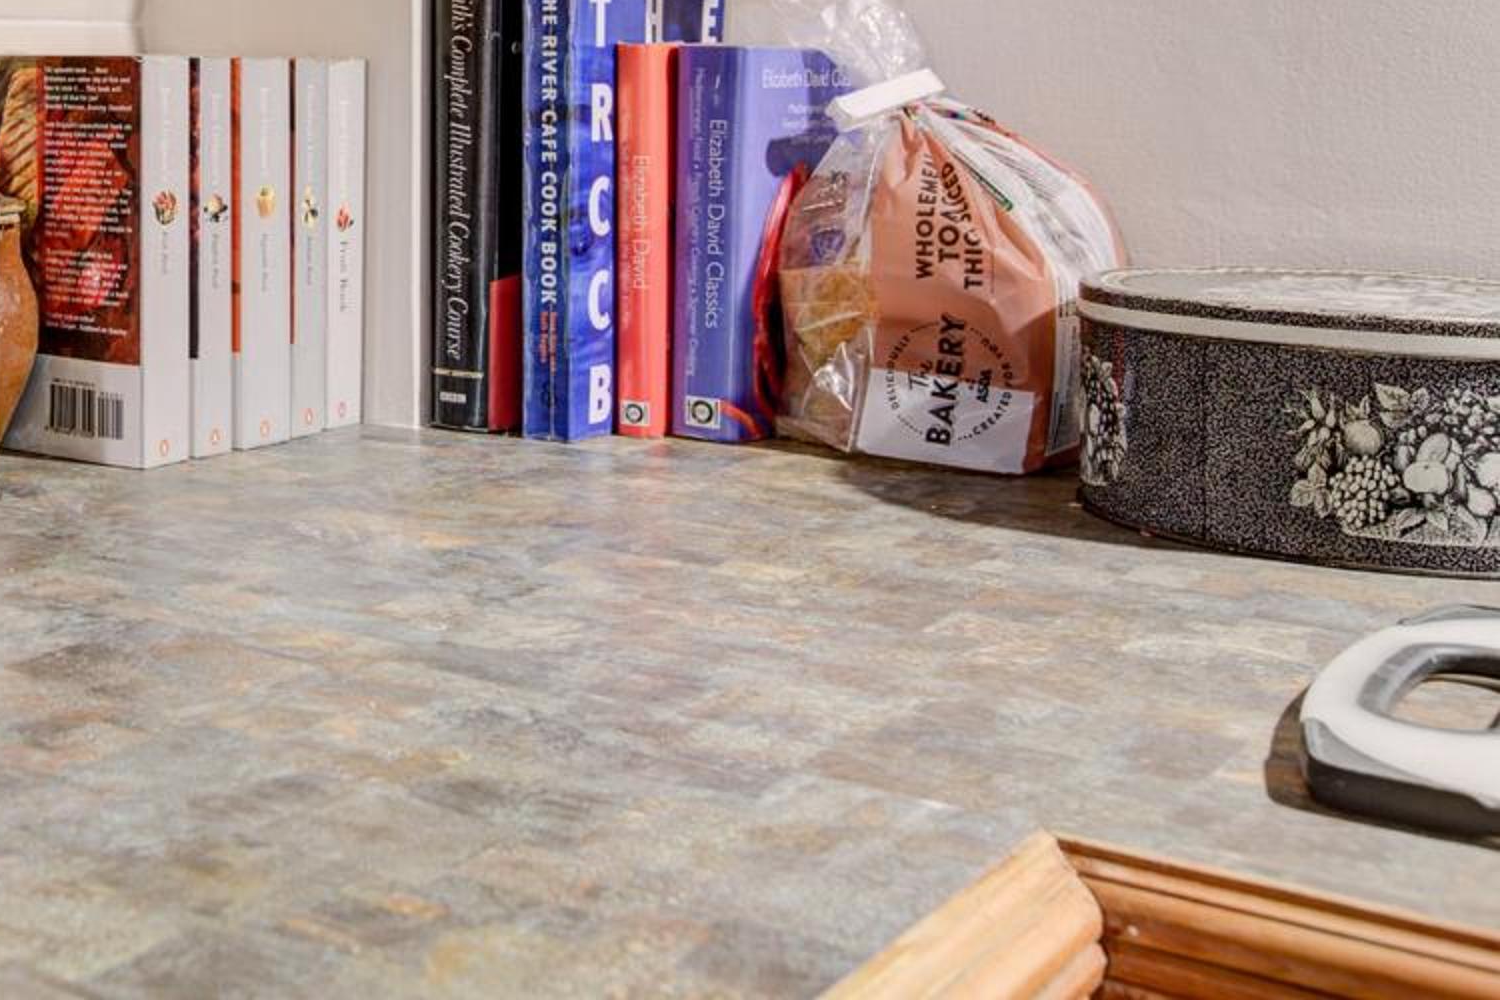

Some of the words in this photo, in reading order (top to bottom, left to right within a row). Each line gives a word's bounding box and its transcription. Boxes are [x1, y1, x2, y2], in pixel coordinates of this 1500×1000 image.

[444, 34, 474, 119] Complete
[541, 35, 558, 101] RIVER
[540, 110, 558, 163] CAFE
[708, 119, 728, 198] Elizabeth
[448, 121, 473, 221] Illustrated
[540, 171, 558, 233] COOK
[441, 220, 471, 292] Cookery
[706, 204, 726, 256] David
[540, 241, 558, 304] BOOK
[632, 238, 652, 290] David
[704, 260, 725, 329] Classics
[446, 297, 469, 361] Course
[925, 312, 964, 446] BAKERY
[972, 391, 1013, 435] CREATED
